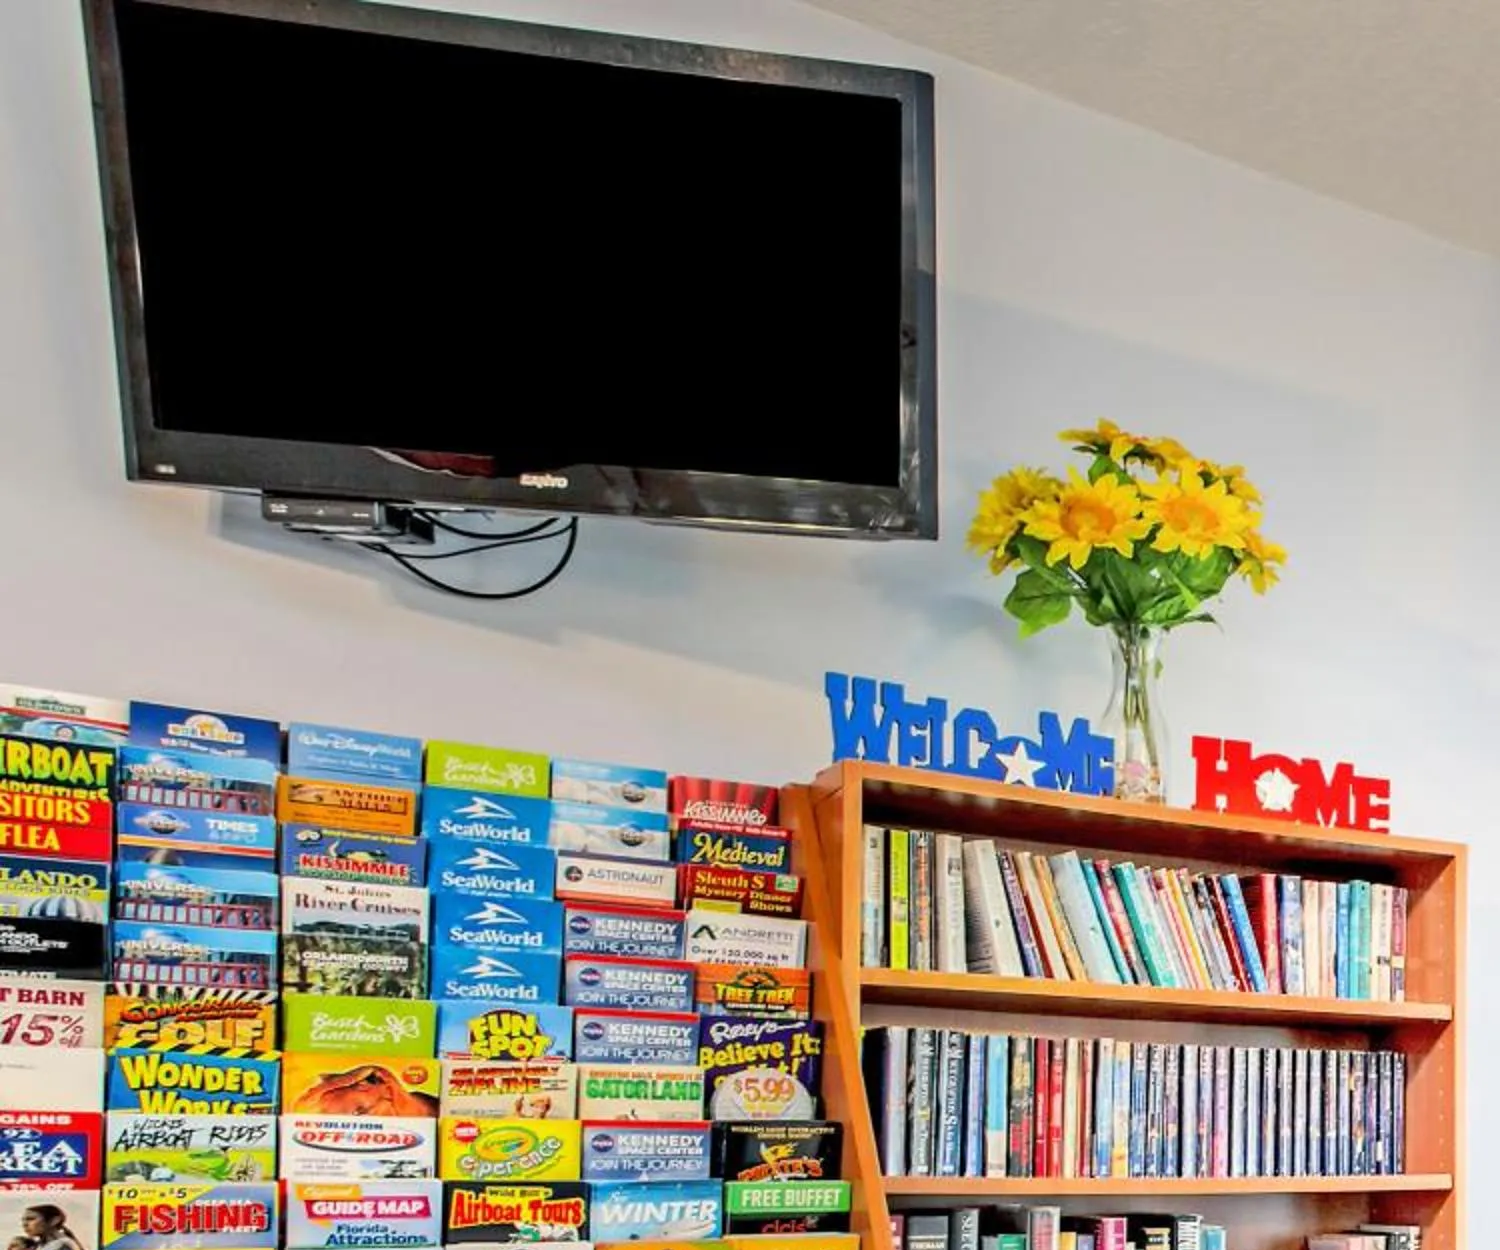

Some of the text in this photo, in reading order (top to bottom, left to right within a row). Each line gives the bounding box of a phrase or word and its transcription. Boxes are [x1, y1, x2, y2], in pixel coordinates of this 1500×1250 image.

[1191, 735, 1391, 833] HOME
[439, 819, 531, 843] SeaWorld
[690, 832, 786, 867] Medieval
[299, 853, 409, 878] KISSIMMEE
[441, 870, 535, 894] SeaWorld
[587, 867, 665, 886] ASTRONAUT
[694, 884, 747, 900] Mystery
[295, 892, 422, 916] River Cruises
[750, 900, 793, 914] Shows
[449, 926, 544, 948] SeaWorld
[595, 917, 678, 938] KENNEDY
[604, 968, 689, 986] KENNEDY
[17, 987, 85, 1007] BARN
[445, 979, 540, 1000] SeaWorld
[115, 1019, 265, 1049] GOLF
[469, 1010, 540, 1041] FUN
[607, 1022, 693, 1040] KENNEDY
[699, 1039, 786, 1071] Believe
[120, 1053, 264, 1096] WONDER
[586, 1079, 702, 1101] GATORLAND
[294, 1120, 384, 1131] REVOLUTION
[113, 1128, 198, 1152] AIRBOAT
[617, 1134, 706, 1148] KENNEDY
[656, 1146, 704, 1156] CENTER
[622, 1157, 647, 1172] THE
[741, 1187, 843, 1208] FREE BUFFET
[113, 1202, 272, 1236] FISHING
[311, 1200, 425, 1217] GUIDE MAP
[452, 1192, 584, 1227] Airboat Tours
[600, 1200, 719, 1226] WINTER
[335, 1222, 390, 1235] Florida
[325, 1232, 429, 1247] Attractions
